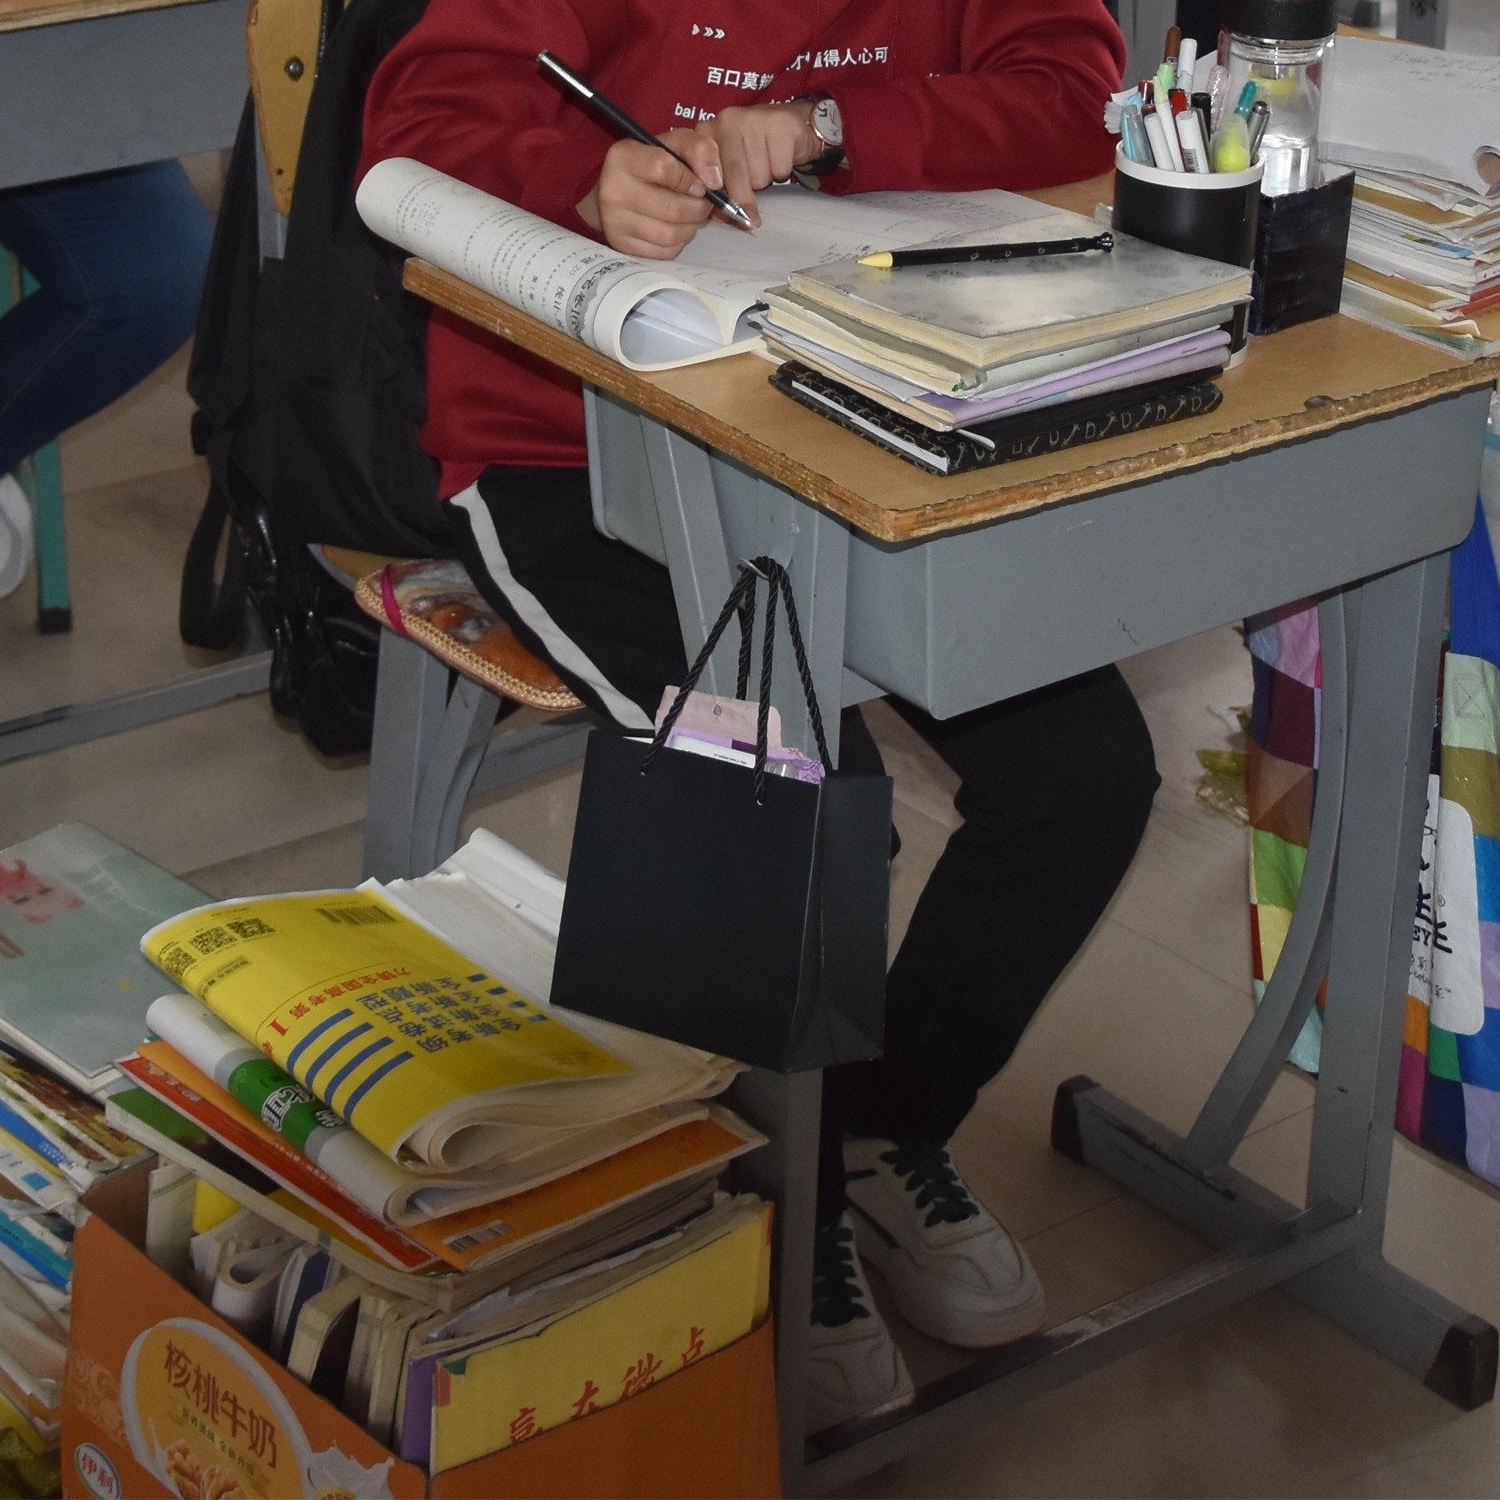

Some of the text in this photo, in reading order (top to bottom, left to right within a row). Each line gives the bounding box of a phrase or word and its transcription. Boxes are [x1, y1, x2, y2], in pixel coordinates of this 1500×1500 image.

[674, 102, 695, 120] bai
[162, 1339, 279, 1470] 核桃牛奶
[80, 1452, 115, 1495] 伊利
